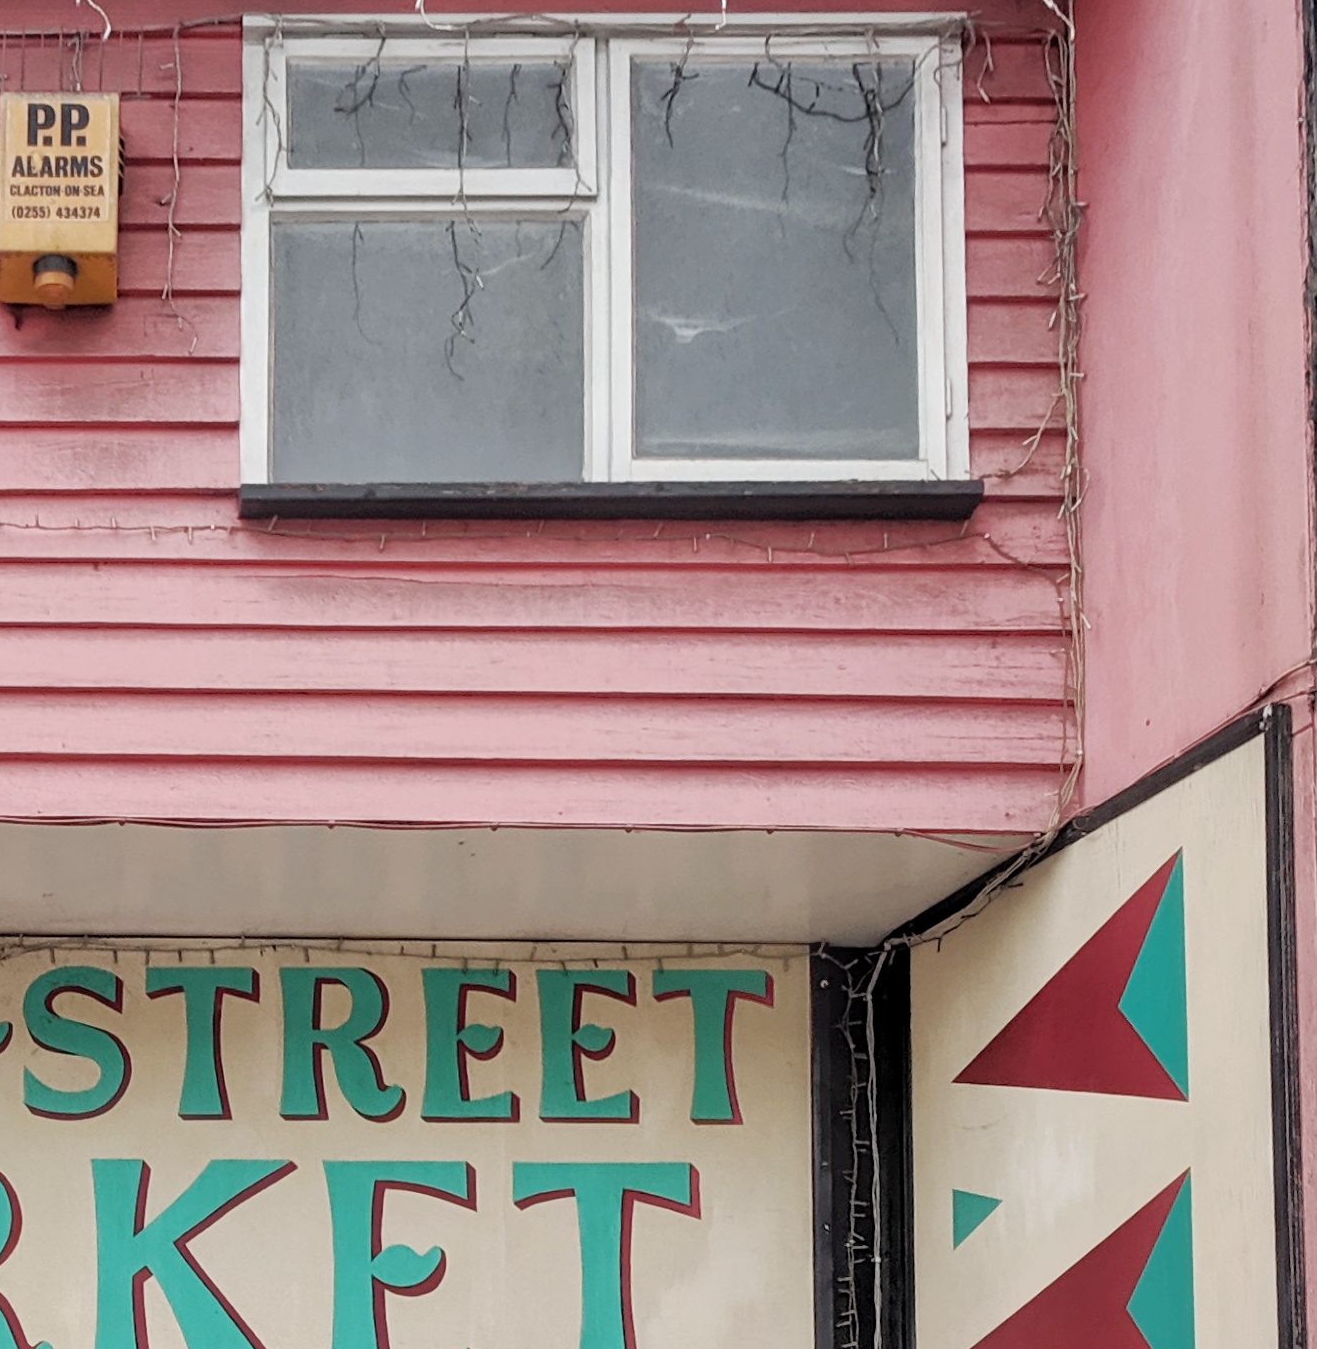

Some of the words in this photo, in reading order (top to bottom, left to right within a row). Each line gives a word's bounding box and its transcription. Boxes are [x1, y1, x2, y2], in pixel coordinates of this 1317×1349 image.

[27, 103, 90, 147] P.P.
[11, 155, 103, 178] ALARMS
[11, 206, 51, 220] (0255)
[55, 206, 101, 220] 434374
[23, 964, 774, 1125] STREET
